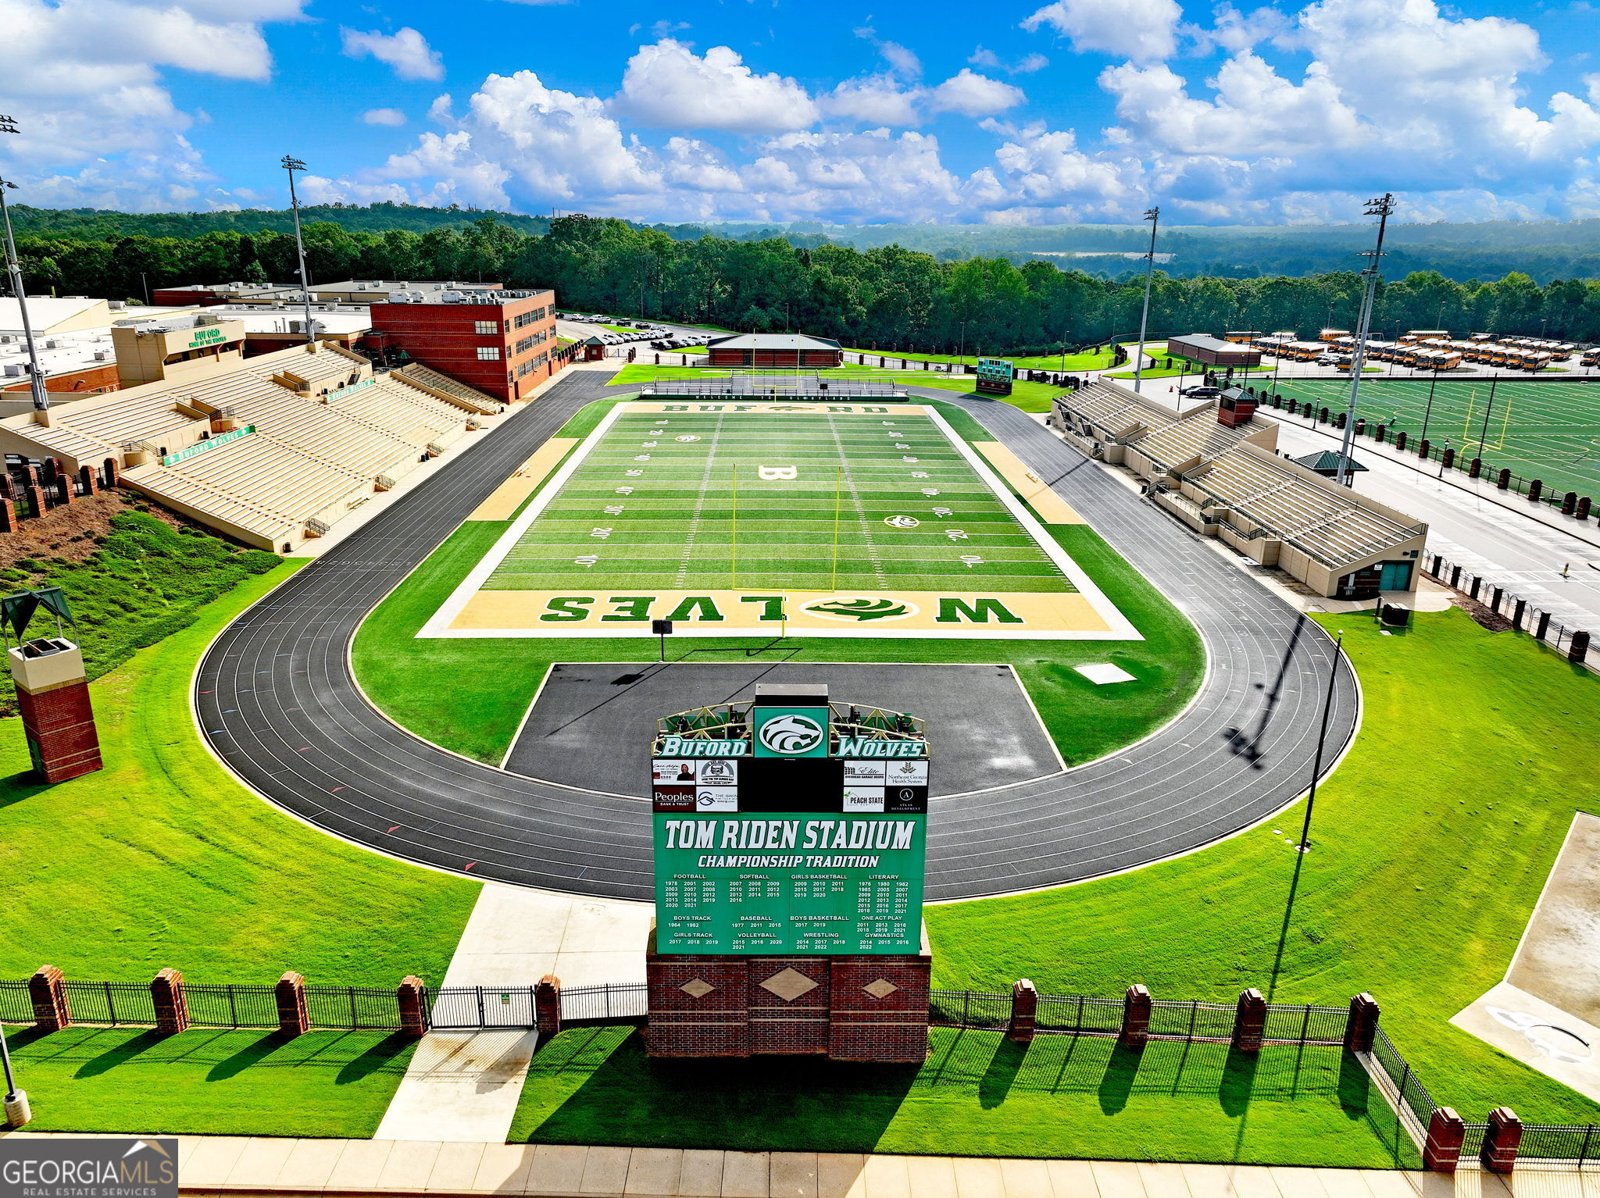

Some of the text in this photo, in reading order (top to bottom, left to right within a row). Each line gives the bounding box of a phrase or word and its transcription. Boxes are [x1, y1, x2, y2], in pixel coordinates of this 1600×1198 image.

[661, 737, 747, 756] BUFORD
[838, 738, 923, 757] WOLVES
[654, 791, 694, 802] Peoples
[665, 820, 916, 849] TOM RIDEN STADIUM
[698, 856, 880, 868] CHAMPIONSHIP TRADITION
